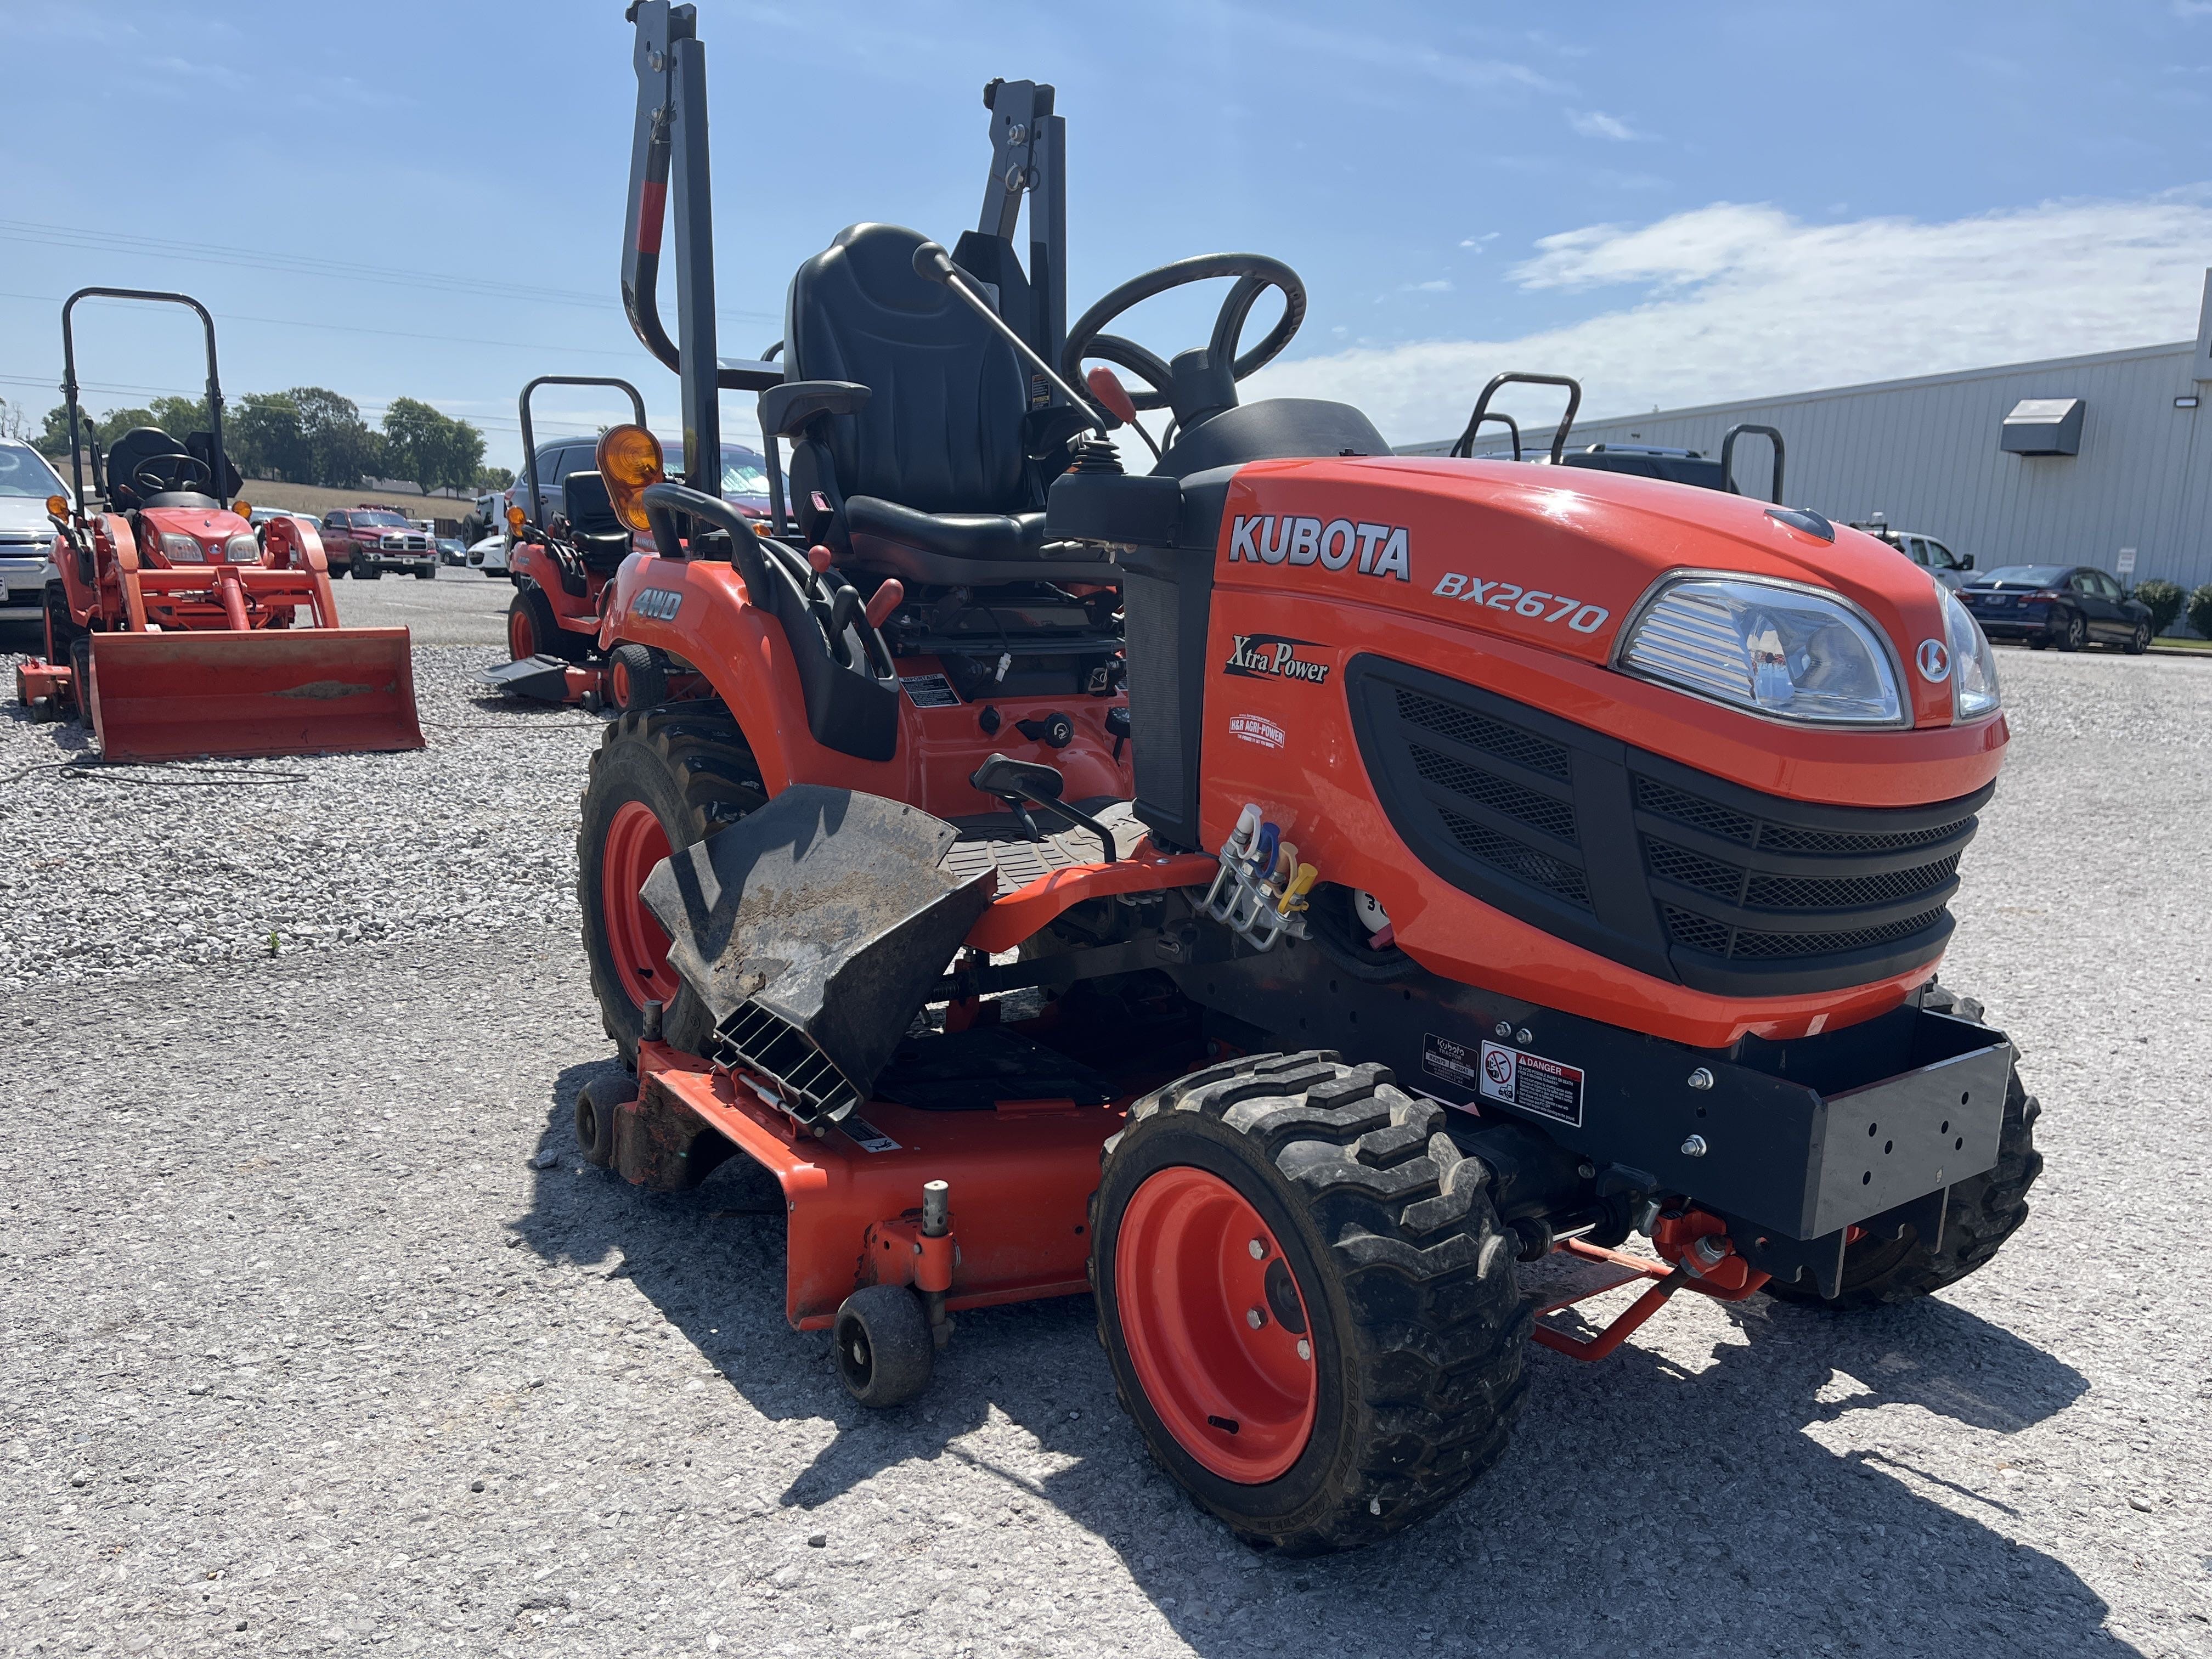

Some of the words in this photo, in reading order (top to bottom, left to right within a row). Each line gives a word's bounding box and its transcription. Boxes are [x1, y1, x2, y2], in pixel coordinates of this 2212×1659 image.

[1229, 515, 1410, 582] KUBOTA
[632, 587, 683, 622] 4WD
[1432, 572, 1610, 634] BX2670
[1226, 634, 1268, 672] Xtra
[1268, 641, 1329, 684] Power
[1231, 719, 1244, 731] H&R
[1245, 720, 1283, 744] AGRI-POWER
[1437, 1039, 1464, 1056] Kubota
[1439, 1048, 1462, 1060] TRACTOR
[1527, 1058, 1562, 1075] DANGER
[1334, 1356, 1359, 1485] GARDEN
